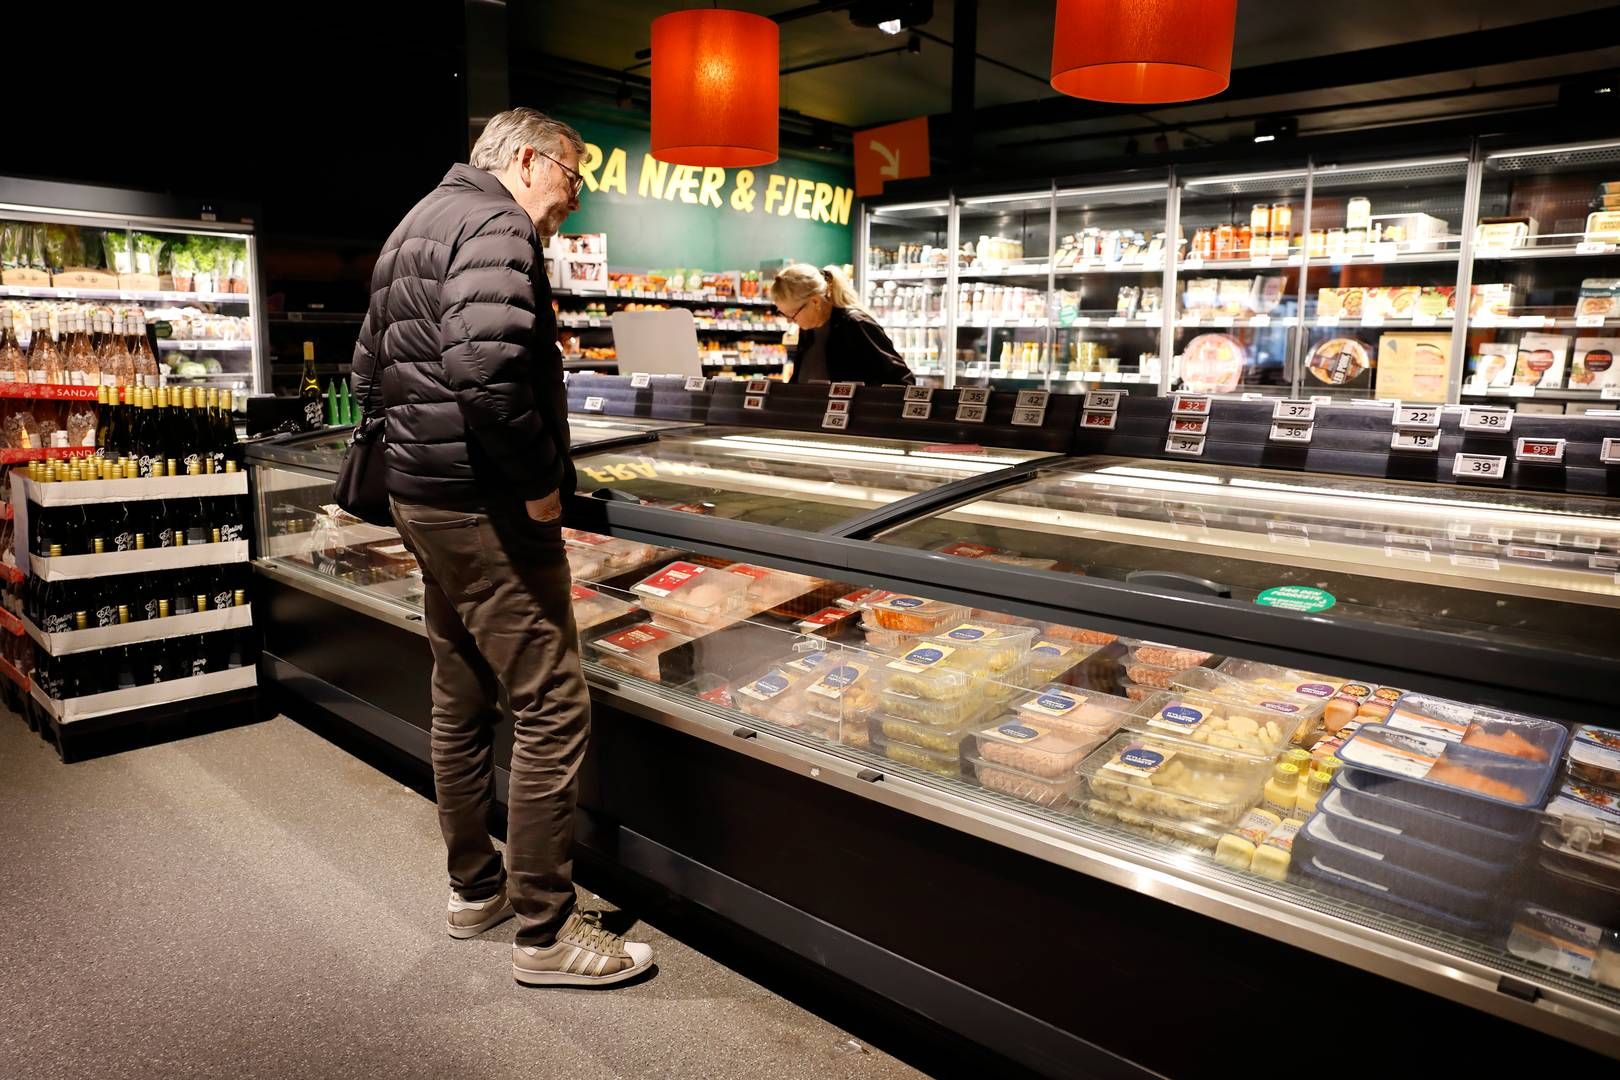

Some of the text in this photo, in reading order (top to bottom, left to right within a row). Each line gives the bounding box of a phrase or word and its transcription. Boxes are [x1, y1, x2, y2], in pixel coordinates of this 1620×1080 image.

[578, 142, 854, 225] RA NÆR & FJERN
[56, 388, 98, 398] SANDA
[1096, 397, 1109, 405] 34
[1186, 401, 1200, 410] 32
[1289, 406, 1305, 415] 37
[1410, 412, 1428, 422] 22
[1479, 415, 1499, 425] 38
[1182, 421, 1197, 430] 20
[1413, 435, 1427, 445] 15
[1533, 445, 1549, 454] 99
[1472, 461, 1491, 472] 39
